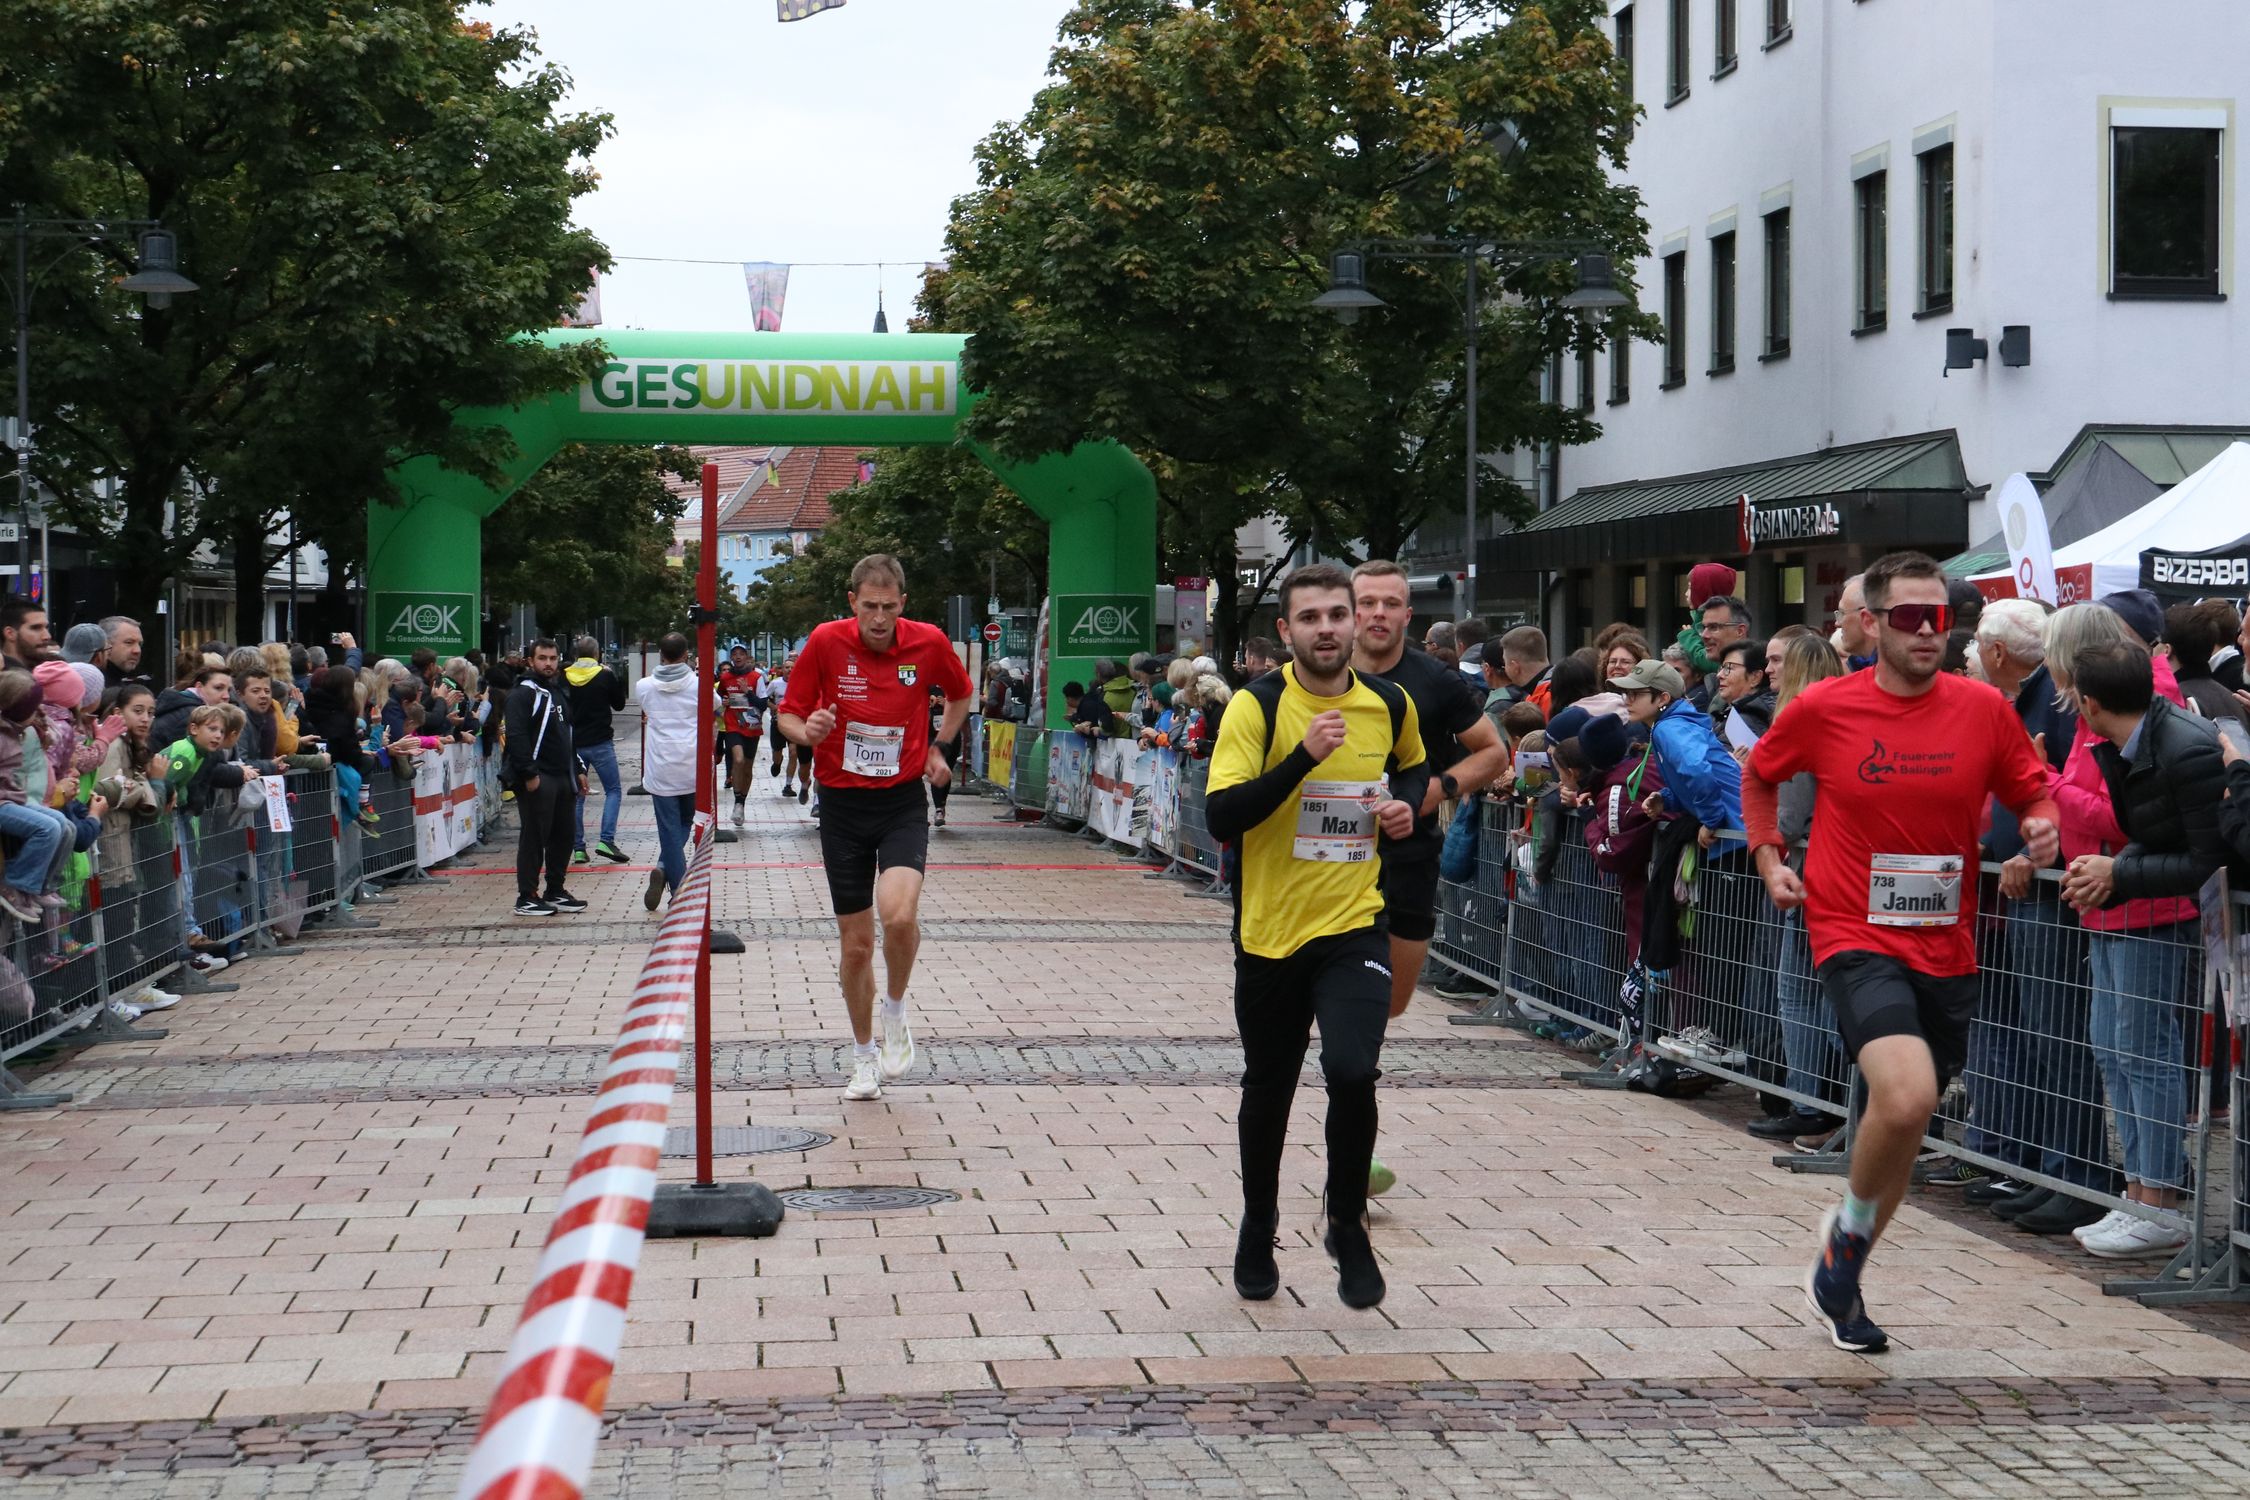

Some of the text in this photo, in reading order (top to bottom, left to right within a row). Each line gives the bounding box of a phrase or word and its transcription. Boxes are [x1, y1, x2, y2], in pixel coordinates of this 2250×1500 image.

[0, 526, 15, 538] rle
[2153, 556, 2249, 586] BIZERBA
[388, 604, 462, 635] AOK
[1070, 605, 1140, 636] AOK
[386, 635, 397, 643] Die
[1068, 636, 1078, 644] Die
[846, 733, 863, 743] 2021
[853, 742, 885, 762] Tom
[1893, 751, 1956, 761] Feuerwehr
[875, 768, 892, 776] 2021
[1900, 764, 1952, 777] Balingen
[1303, 801, 1328, 813] 1851
[1321, 816, 1359, 835] Max
[1347, 851, 1366, 861] 1851
[1873, 876, 1896, 888] 738
[1882, 891, 1948, 912] Jannik
